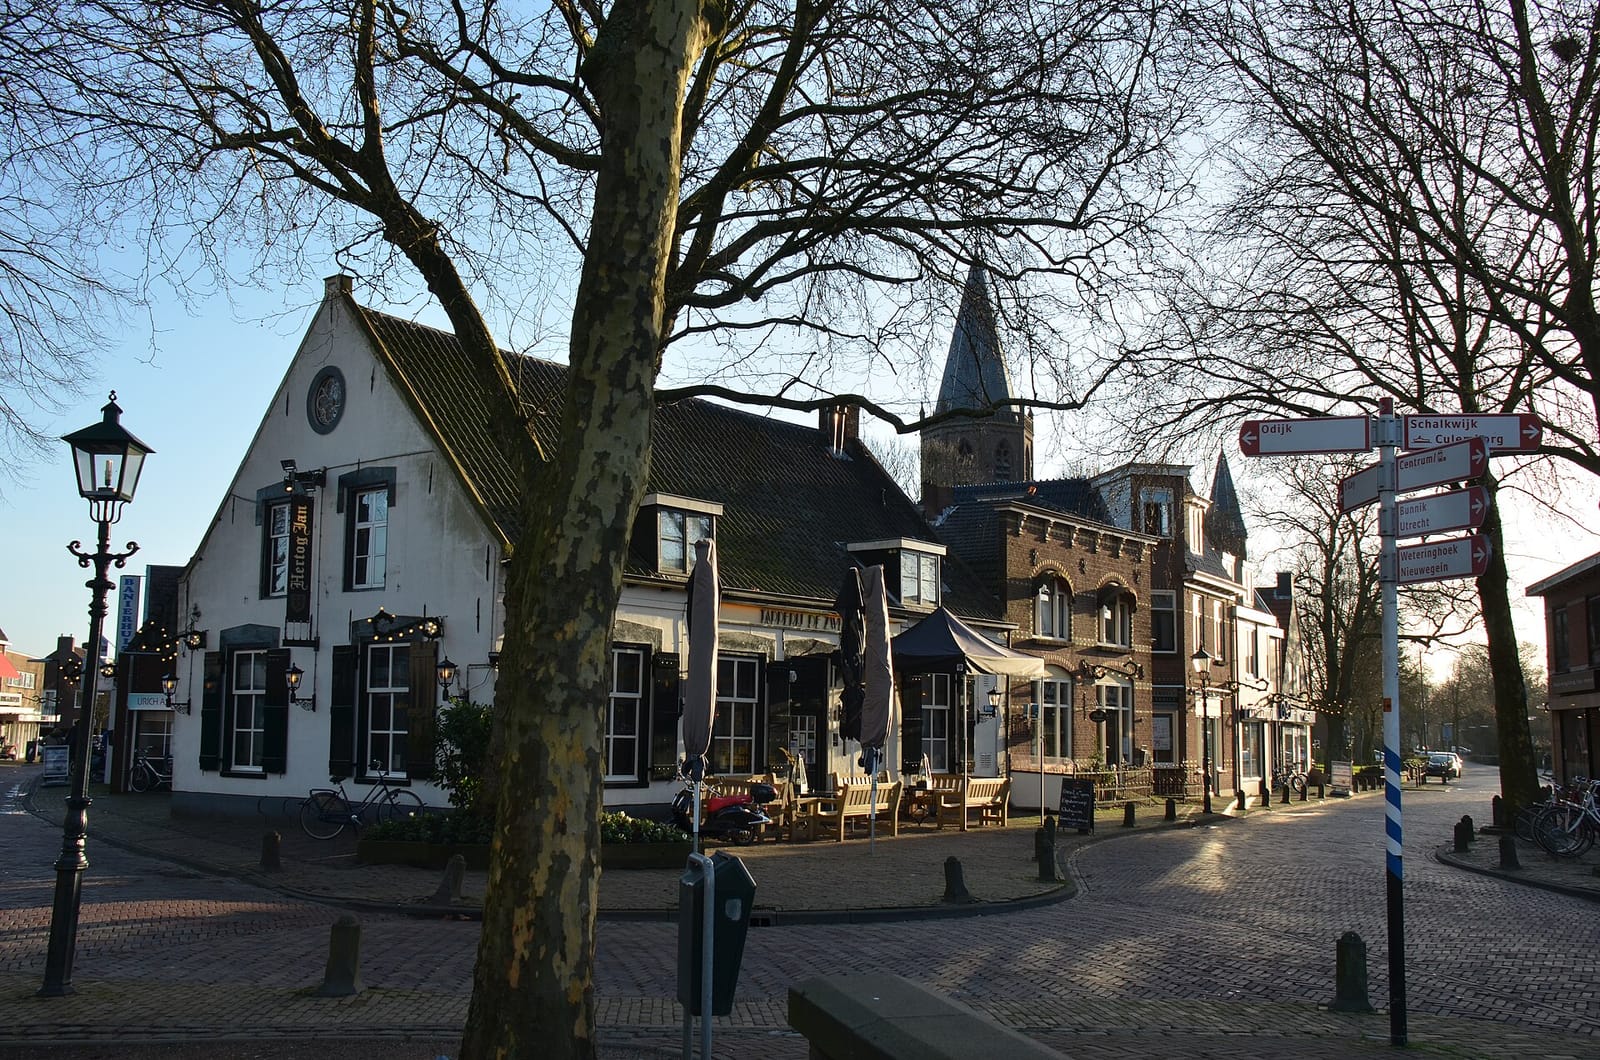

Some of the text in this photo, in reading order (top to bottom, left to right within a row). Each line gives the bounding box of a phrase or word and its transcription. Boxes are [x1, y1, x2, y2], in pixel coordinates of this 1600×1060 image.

[1261, 423, 1292, 435] Odijk
[1410, 419, 1478, 431] Schalkwijk
[1400, 503, 1427, 516] Bunnik
[1400, 519, 1430, 531] Utrecht
[290, 504, 309, 591] Hertog Jan
[1400, 544, 1458, 561] Weteringhoek
[1400, 563, 1448, 577] Nieuwegein
